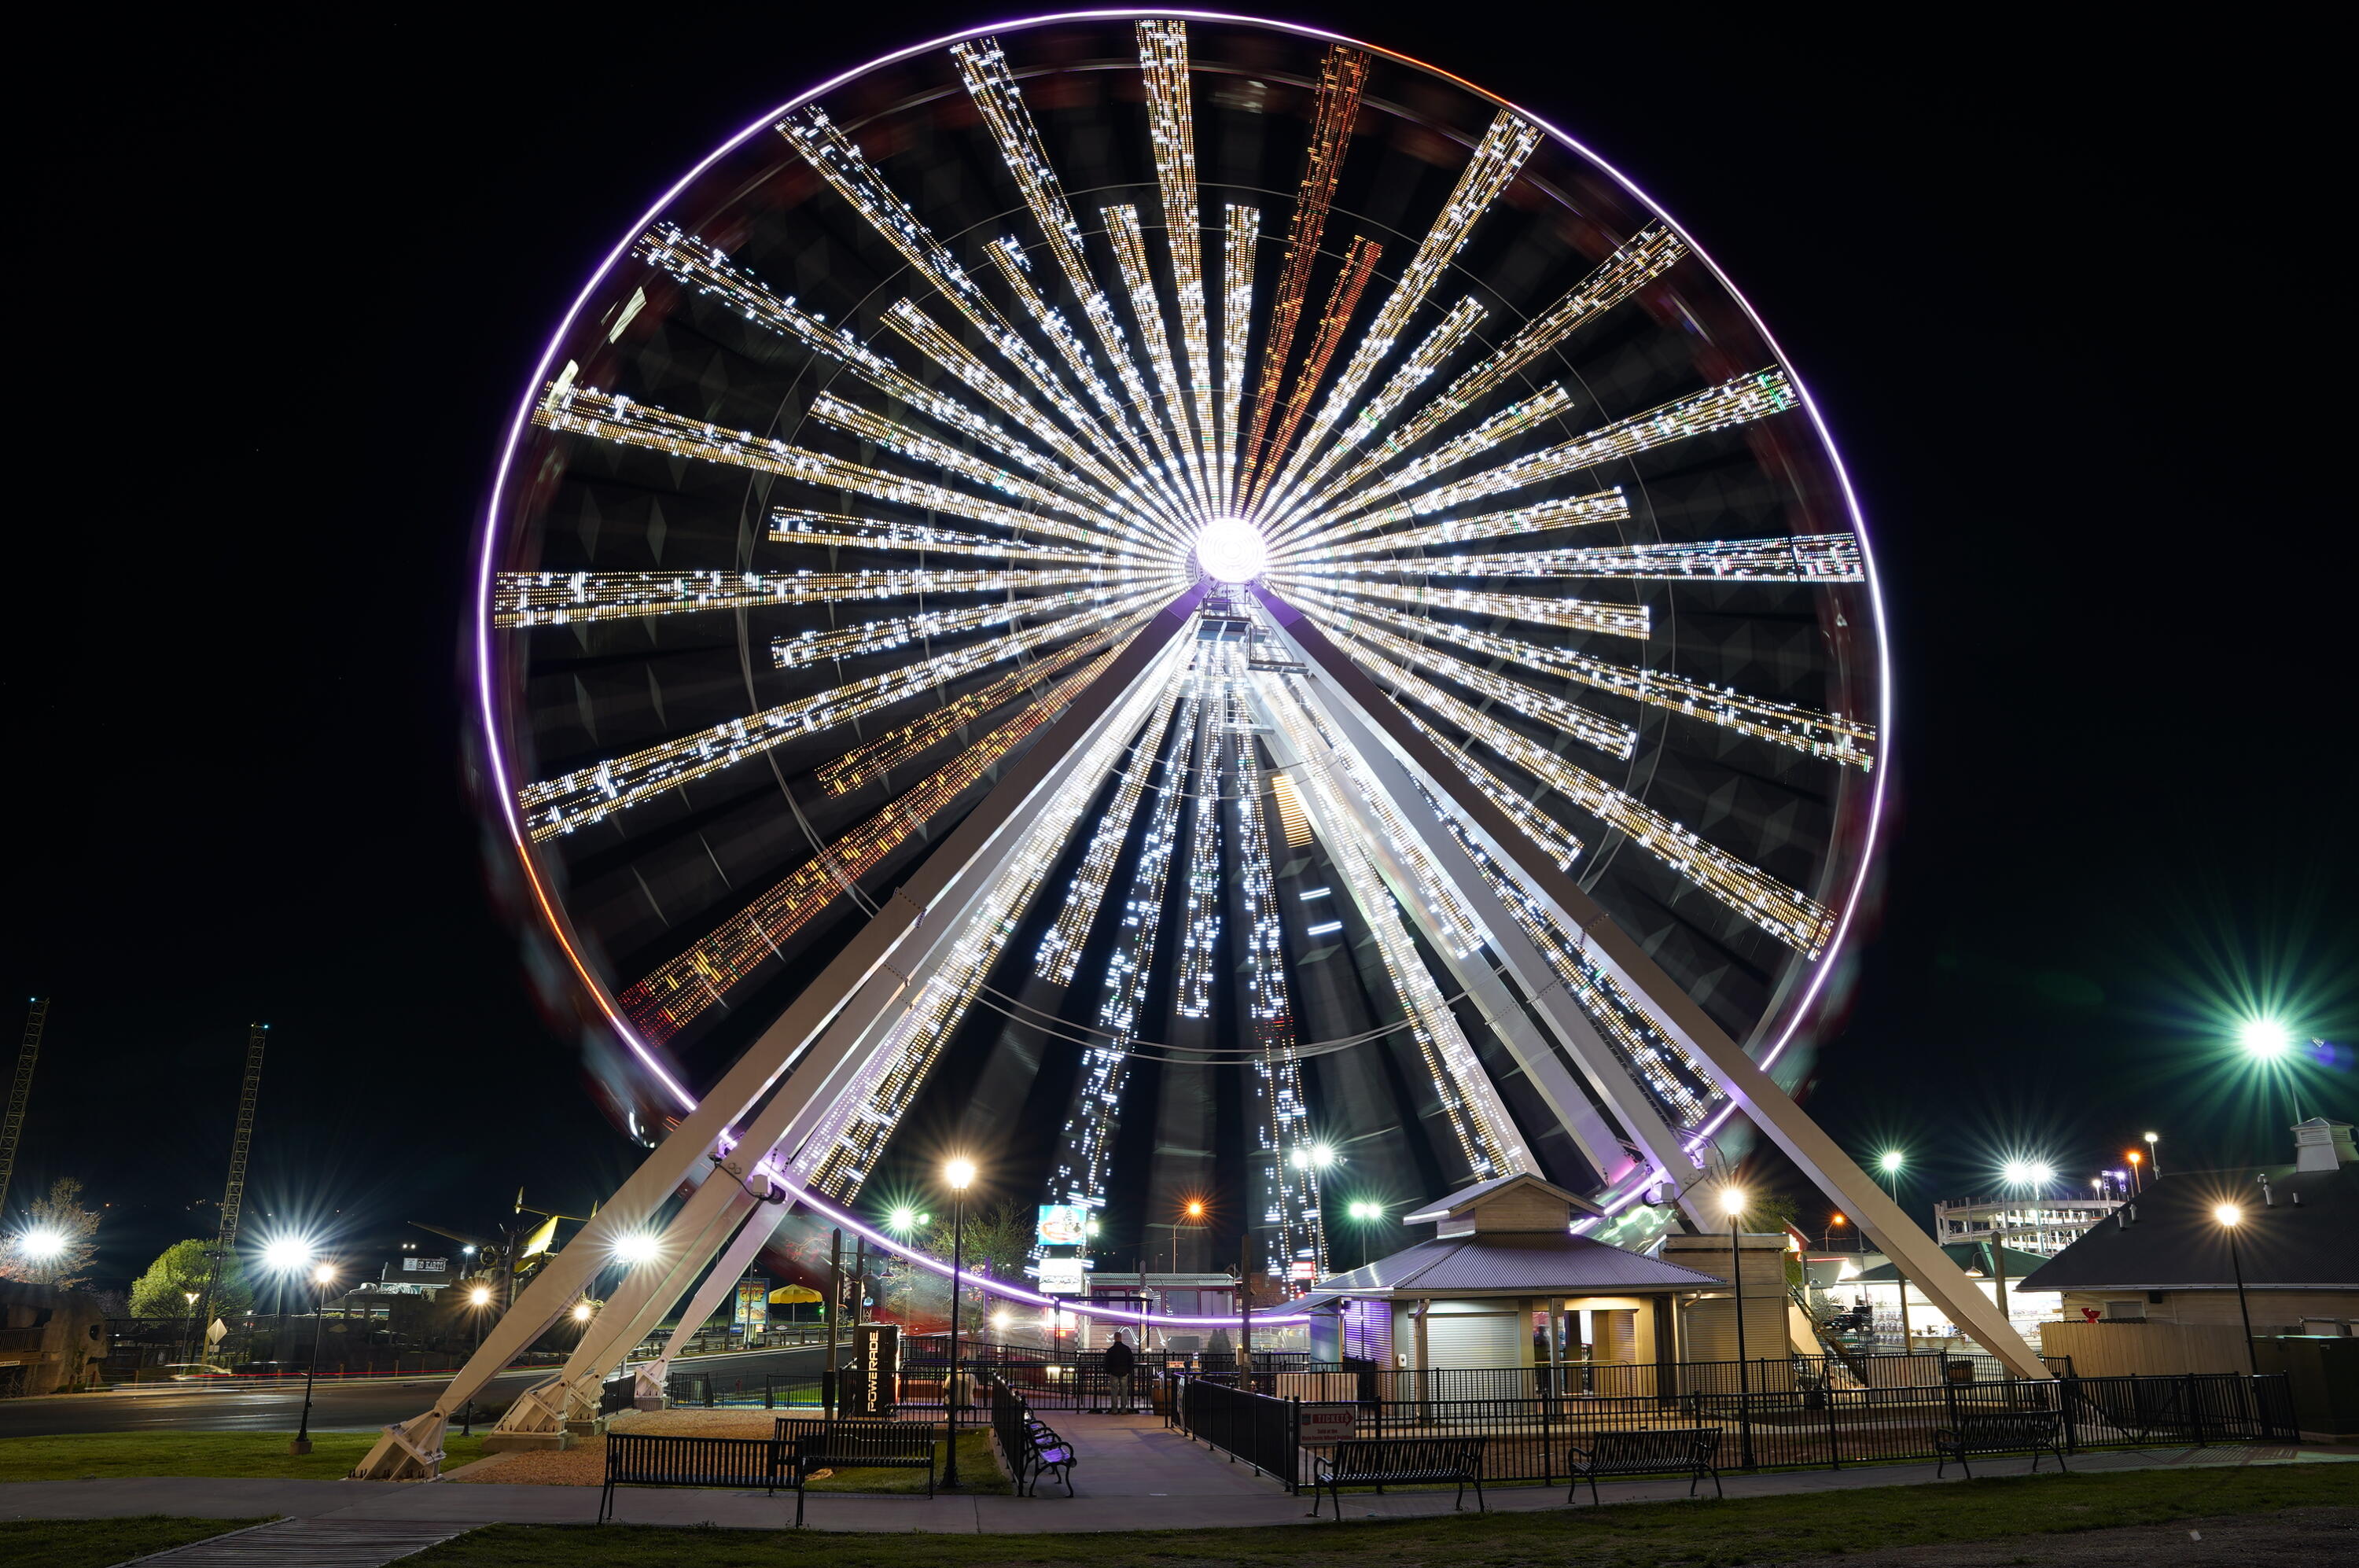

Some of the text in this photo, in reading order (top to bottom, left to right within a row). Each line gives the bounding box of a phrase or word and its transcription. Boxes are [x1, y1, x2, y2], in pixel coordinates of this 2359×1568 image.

[418, 1261, 425, 1269] GO
[425, 1261, 443, 1270] KARTS
[867, 1331, 878, 1412] POWERADE
[1318, 1415, 1349, 1423] TICKETS
